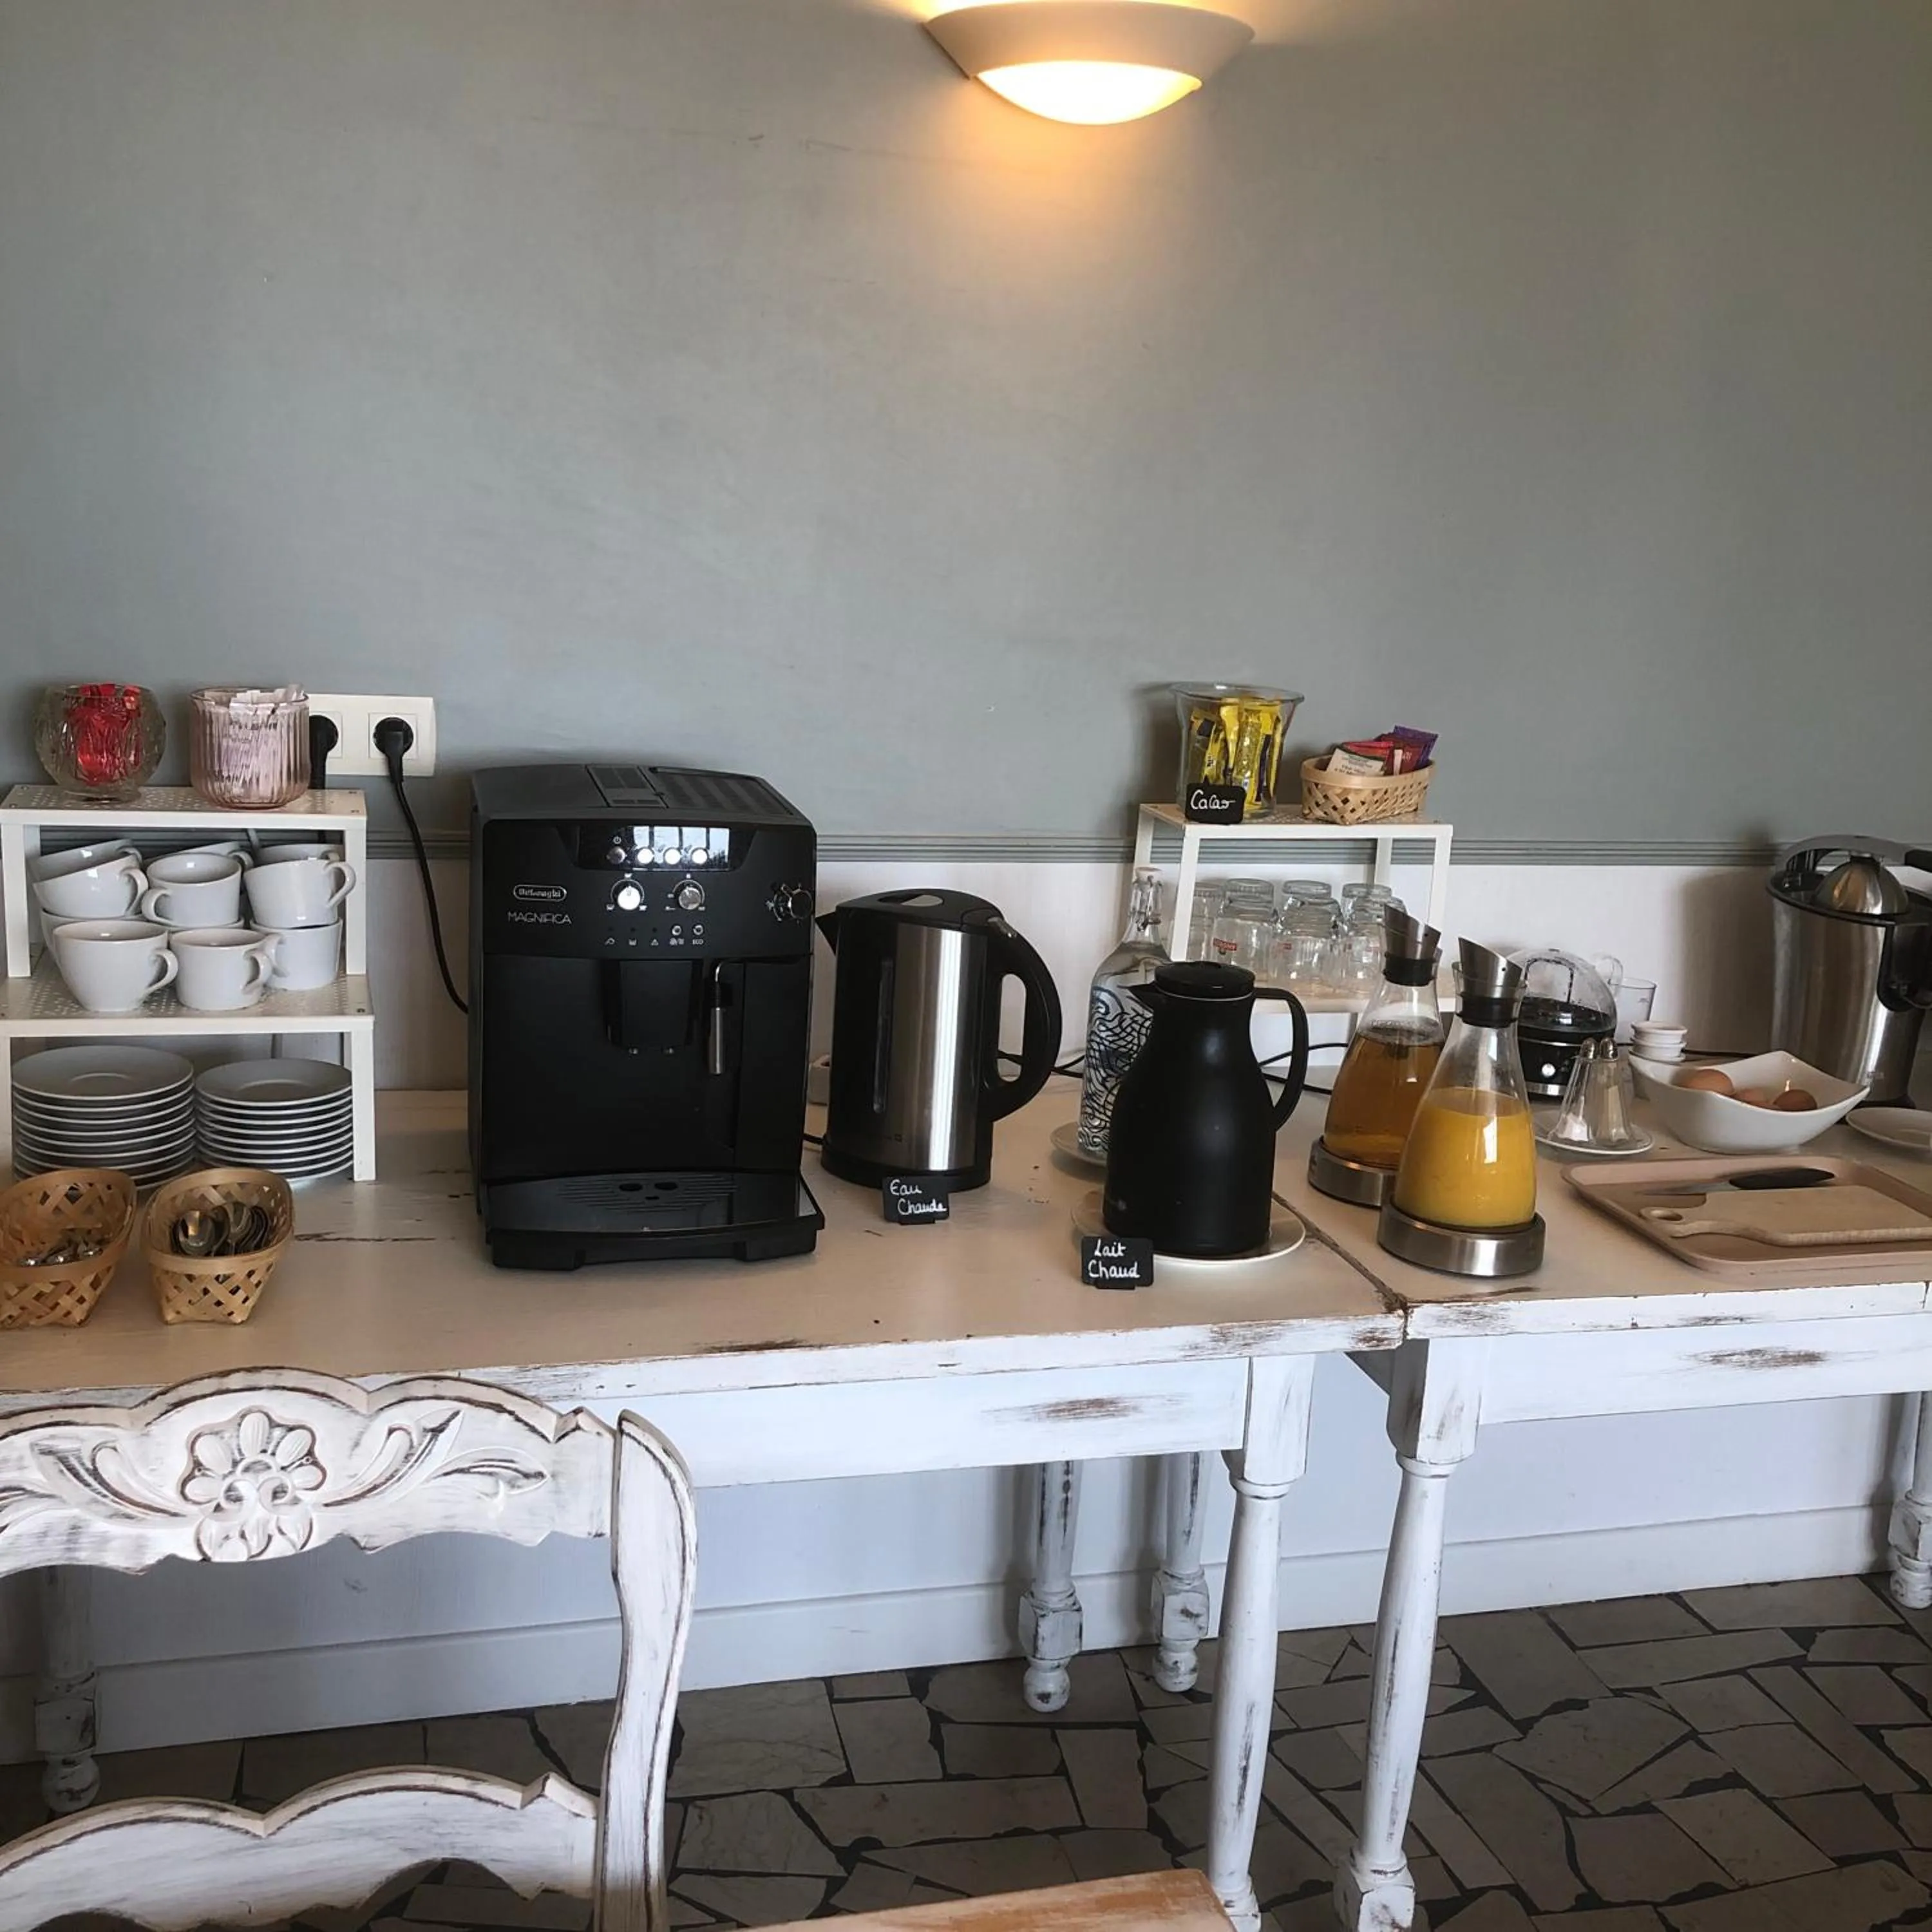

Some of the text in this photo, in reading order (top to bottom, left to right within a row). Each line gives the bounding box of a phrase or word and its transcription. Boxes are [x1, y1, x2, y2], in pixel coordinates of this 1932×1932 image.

[507, 911, 572, 924] MAGNIFICA
[890, 1179, 923, 1196] Eau
[897, 1198, 947, 1215] Chaude
[1094, 1238, 1127, 1257] Lait
[1088, 1259, 1141, 1279] Chaud
